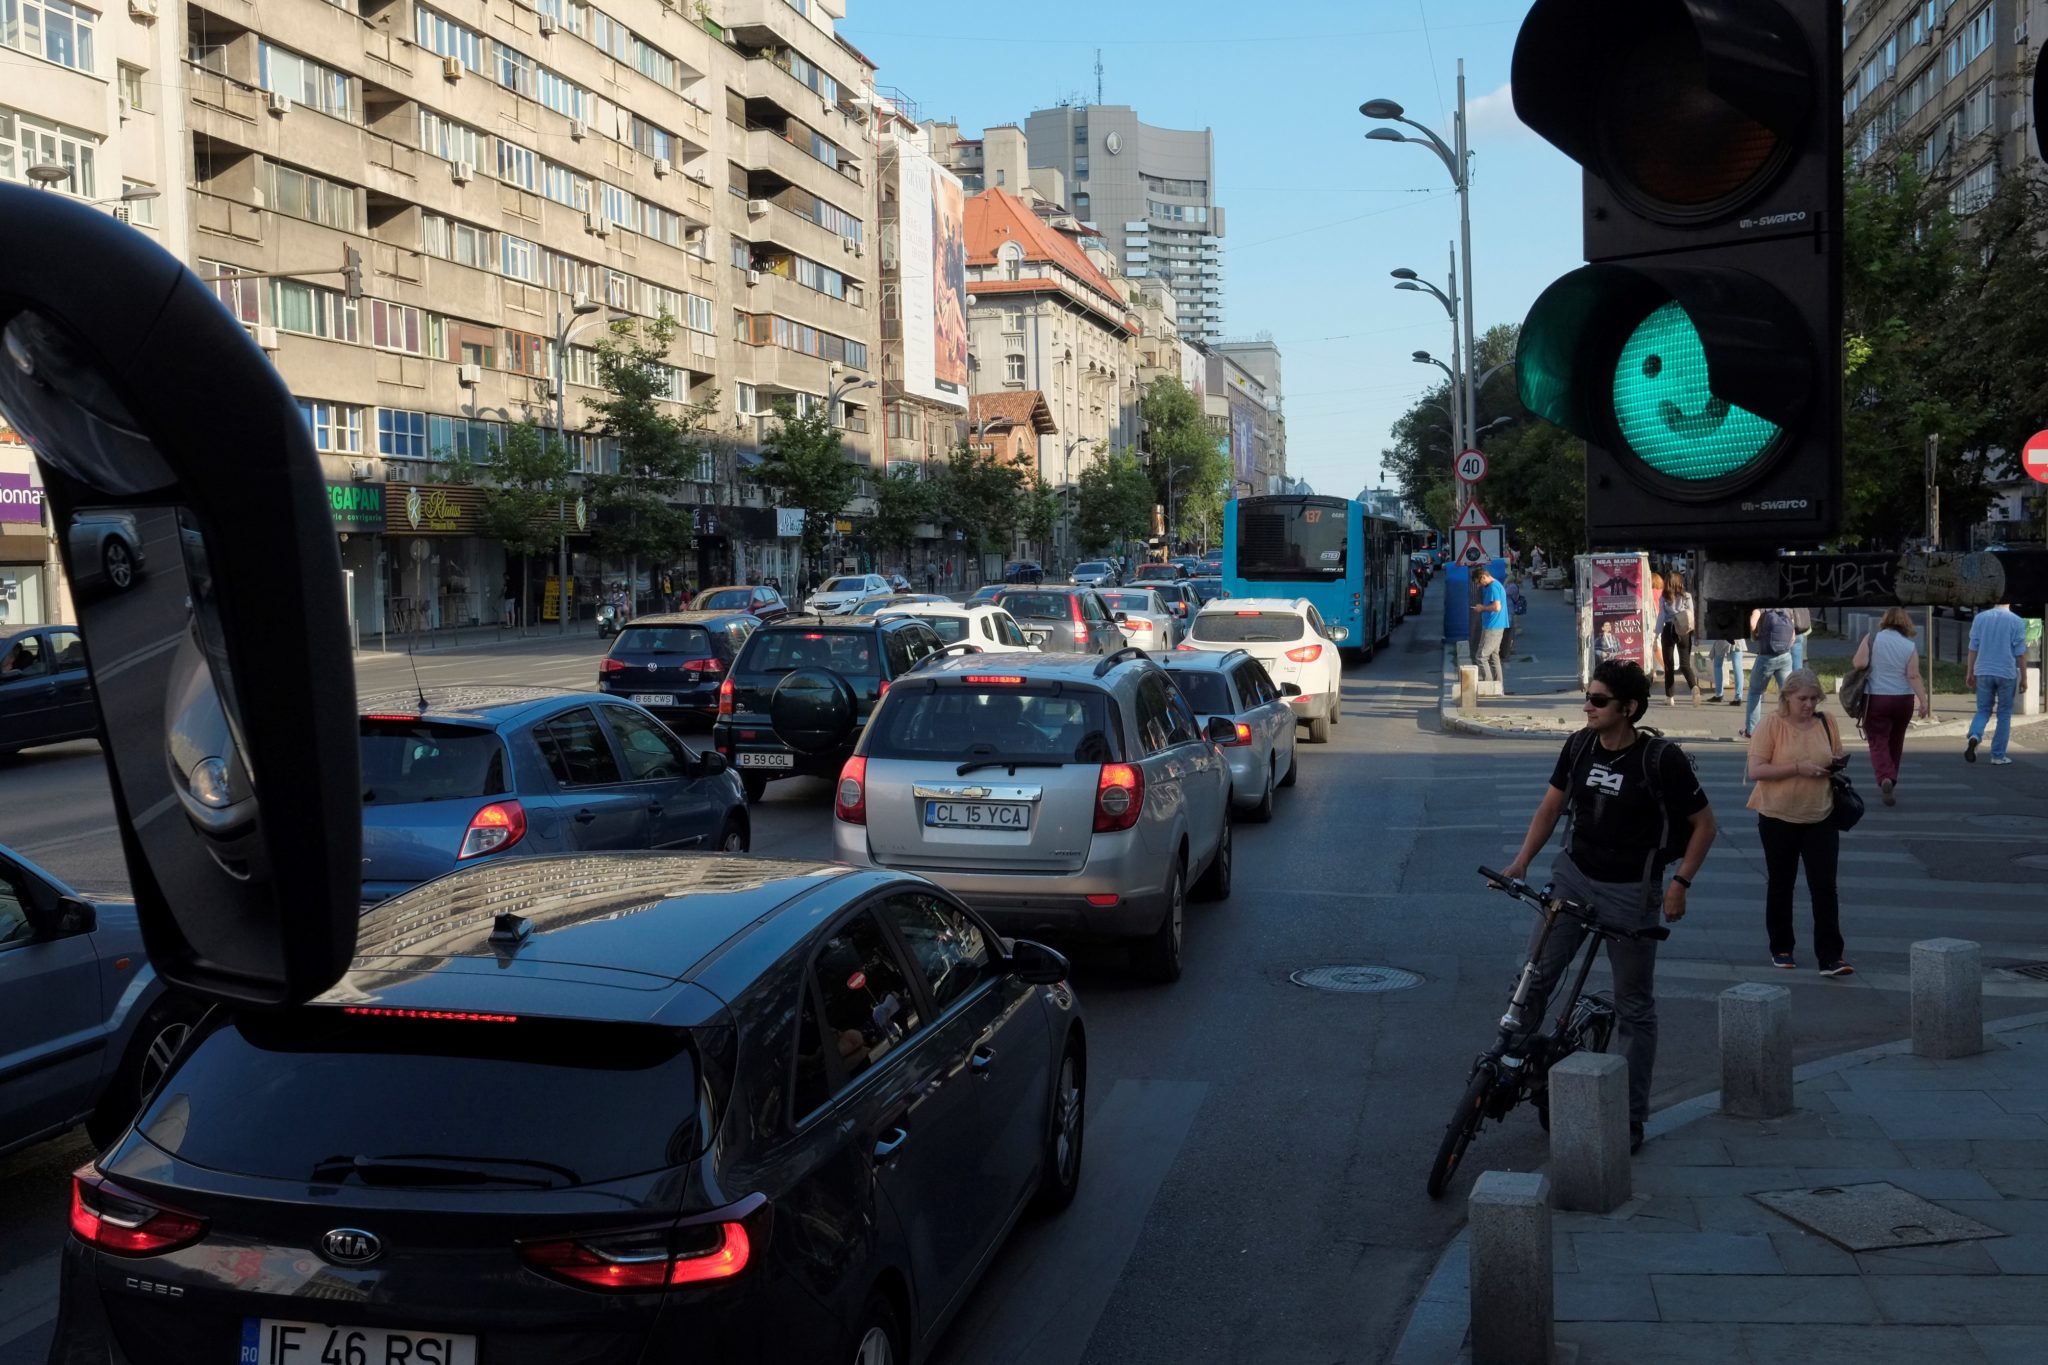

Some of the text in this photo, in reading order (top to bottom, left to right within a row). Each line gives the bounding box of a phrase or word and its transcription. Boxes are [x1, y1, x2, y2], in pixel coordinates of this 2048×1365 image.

[1462, 459, 1480, 474] 40
[1305, 510, 1322, 523] 137
[654, 695, 671, 703] CWS
[743, 754, 789, 766] B 59 CGL
[1585, 768, 1624, 791] 24
[937, 805, 959, 822] CL
[965, 806, 981, 822] 15
[987, 807, 1022, 825] YCA
[329, 1235, 371, 1256] KIA
[241, 1346, 258, 1363] RO
[270, 1325, 306, 1365] IF
[321, 1330, 367, 1365] 46
